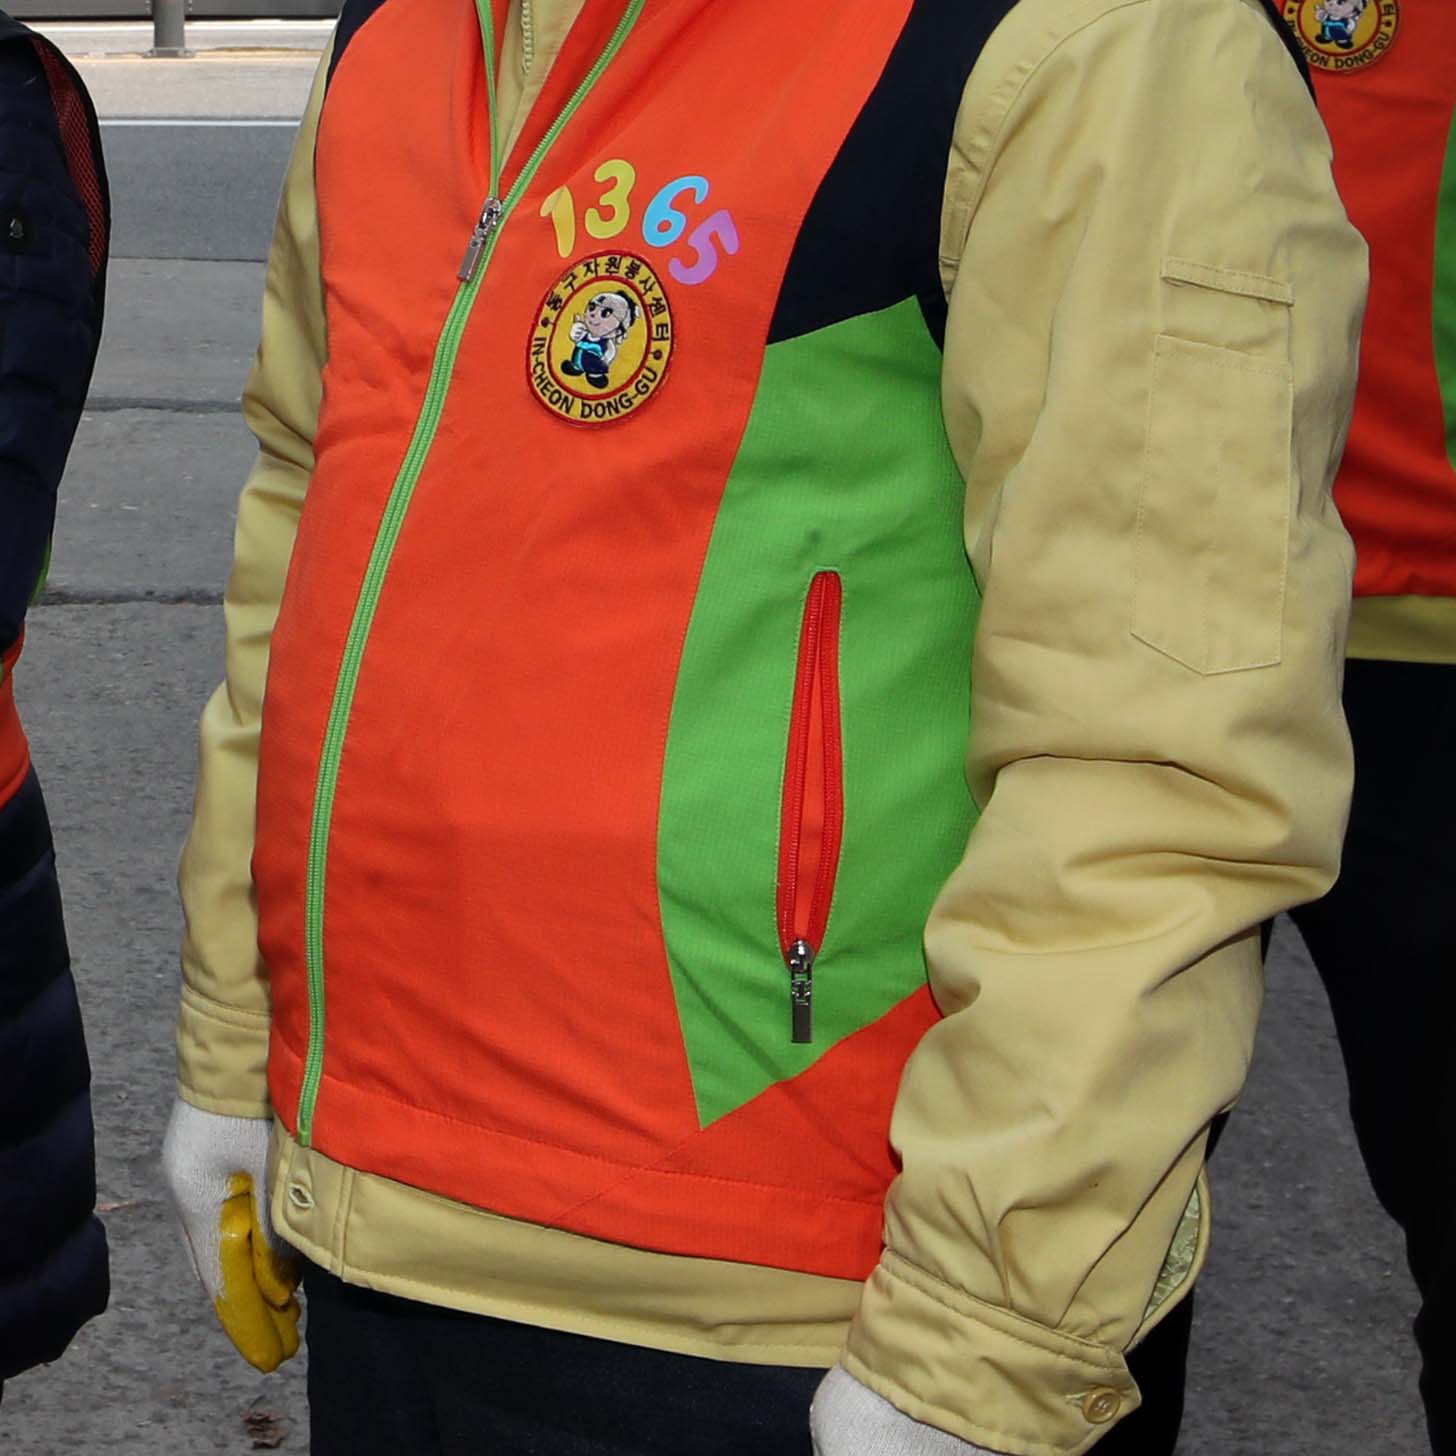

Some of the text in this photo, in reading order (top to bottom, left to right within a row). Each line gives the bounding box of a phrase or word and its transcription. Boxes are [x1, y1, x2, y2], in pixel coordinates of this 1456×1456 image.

[540, 159, 741, 285] 1365
[545, 255, 670, 342] 동구자원봉사센터
[531, 336, 659, 420] IN-CHEON DONG-GU
